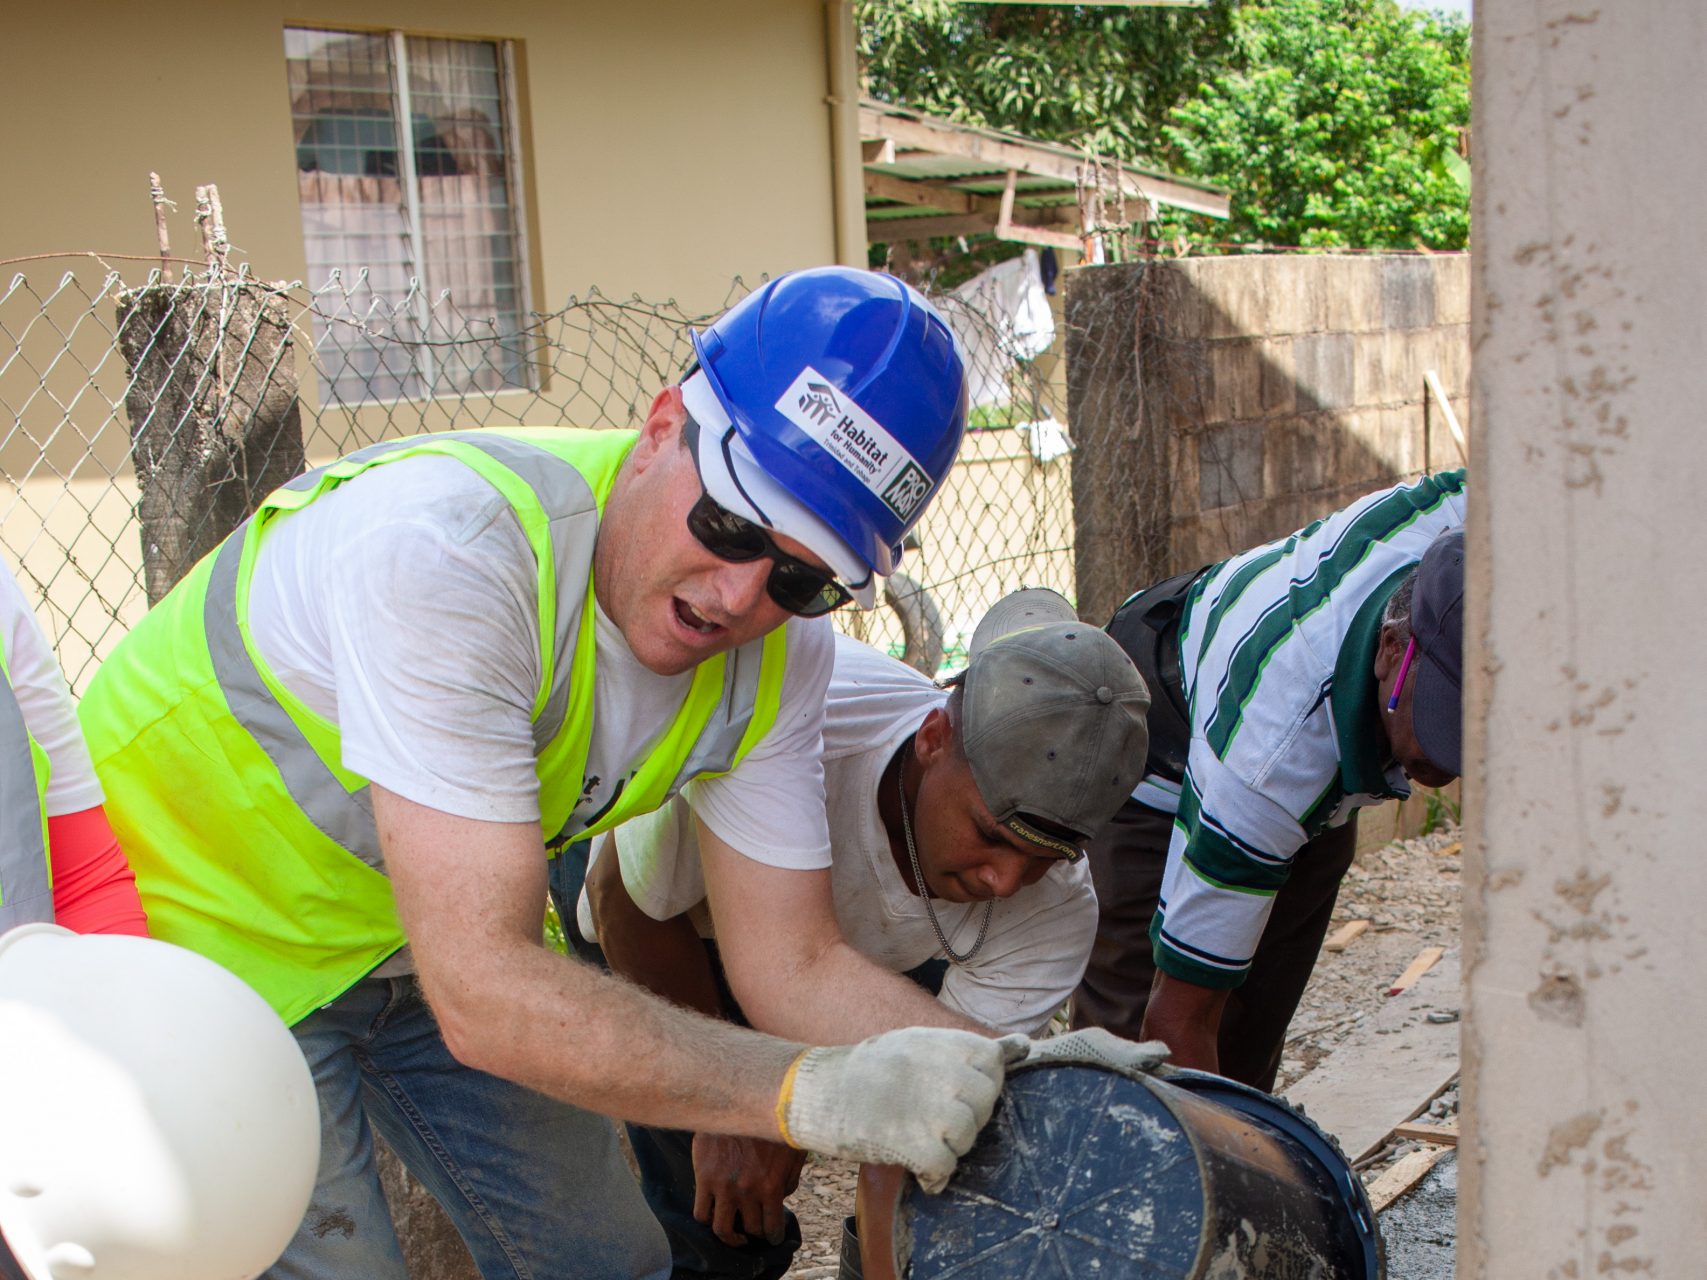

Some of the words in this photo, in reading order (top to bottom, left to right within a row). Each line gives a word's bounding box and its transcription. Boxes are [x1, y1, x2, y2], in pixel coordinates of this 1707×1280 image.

[830, 429, 843, 443] for
[843, 440, 877, 475] Humanity
[837, 415, 888, 466] Habitat
[900, 467, 926, 500] PRO
